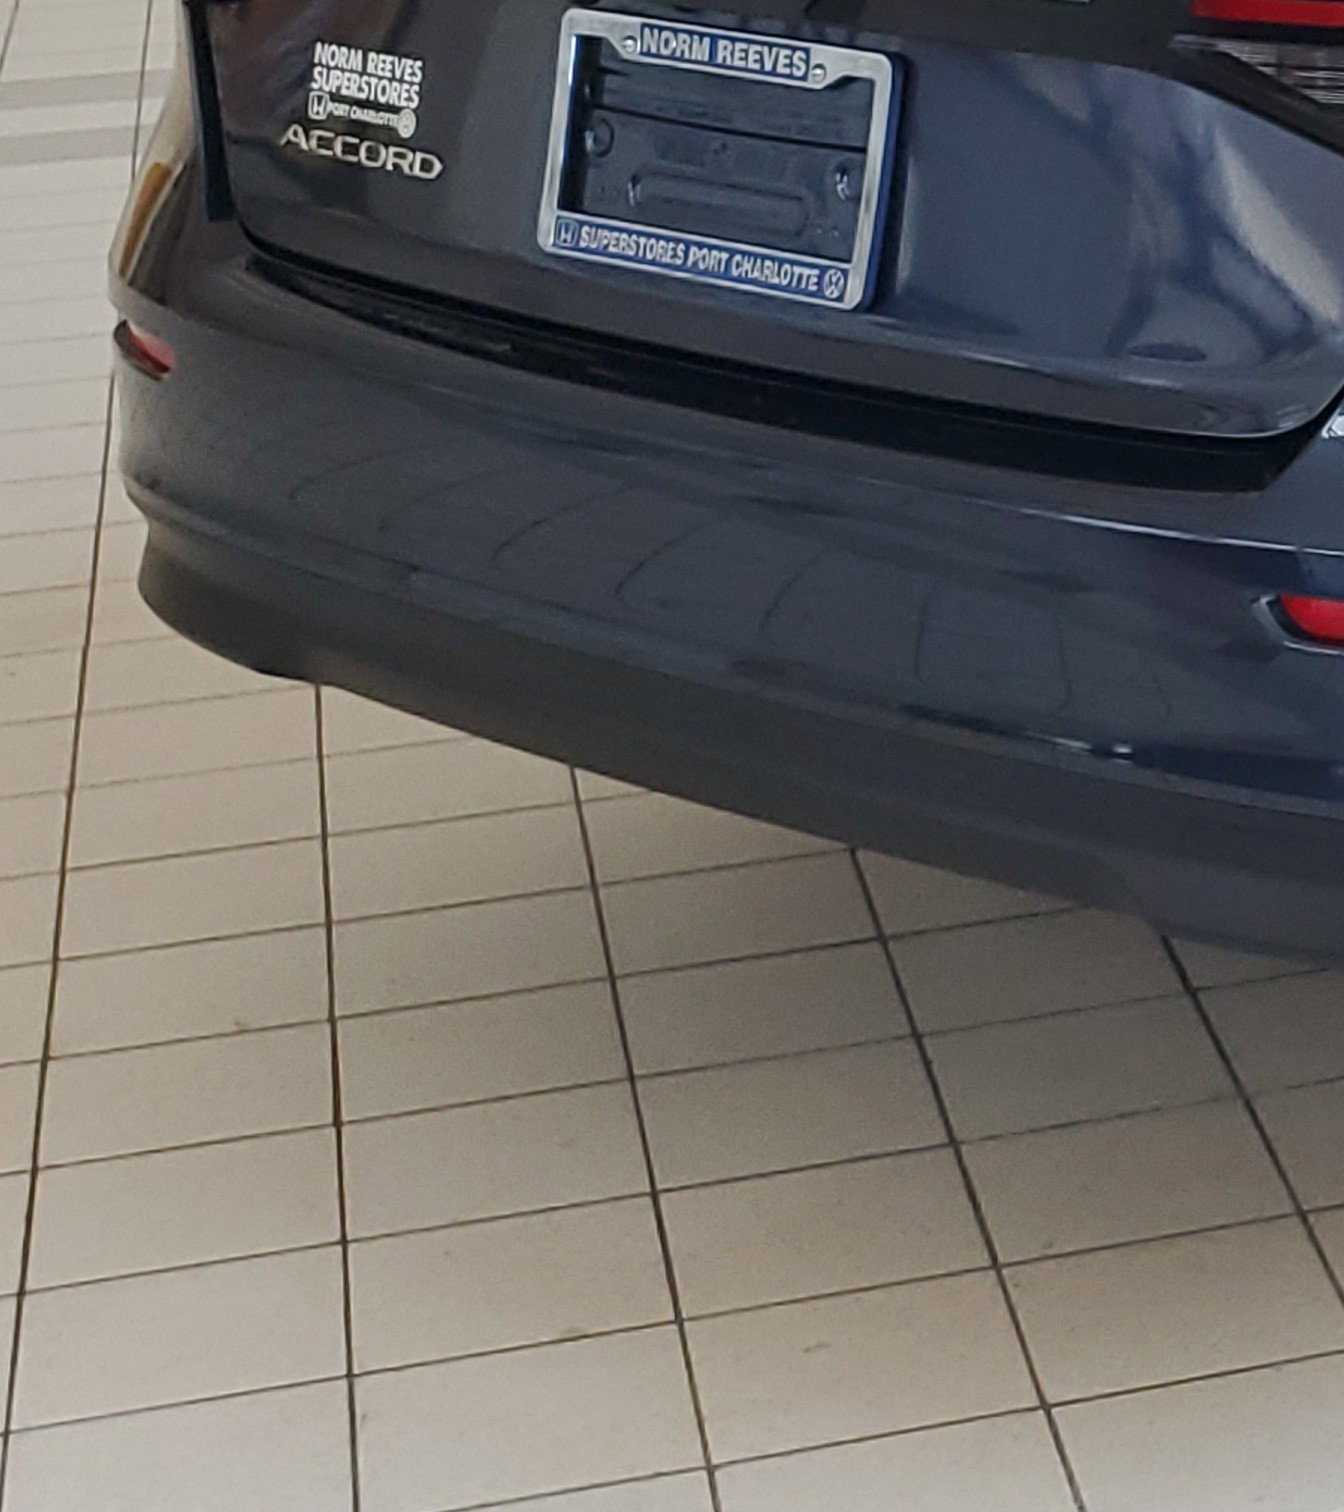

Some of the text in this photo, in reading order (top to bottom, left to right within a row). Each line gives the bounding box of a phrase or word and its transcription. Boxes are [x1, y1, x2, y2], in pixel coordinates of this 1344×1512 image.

[313, 41, 424, 85] NORM REEVES
[641, 26, 808, 77] NORM REEVES
[310, 65, 421, 110] SUPERSTORES
[279, 123, 444, 180] ACCORD
[578, 224, 820, 291] SUPERSTORES PORT CHARLOTTE
